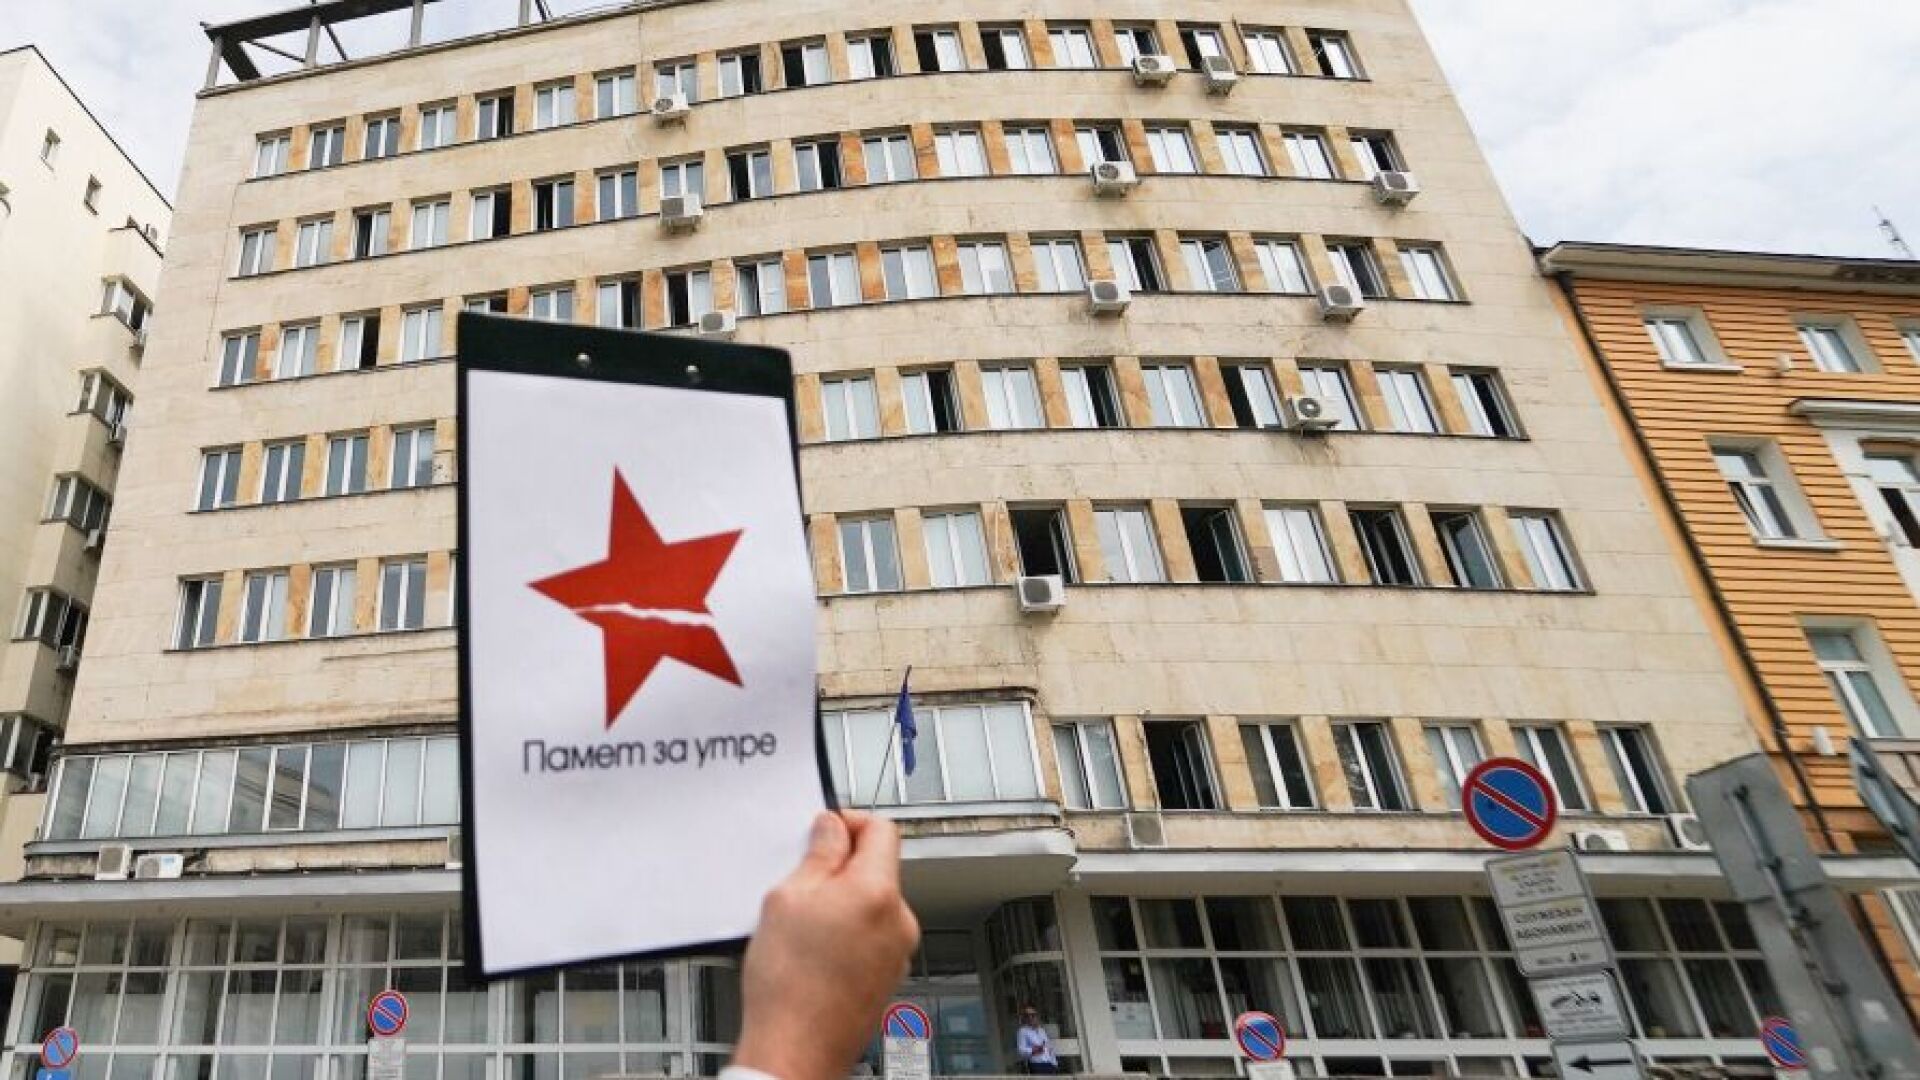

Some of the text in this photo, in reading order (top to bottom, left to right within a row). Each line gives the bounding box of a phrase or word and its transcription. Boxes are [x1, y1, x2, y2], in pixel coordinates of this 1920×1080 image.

[524, 732, 777, 773] Памет за утре
